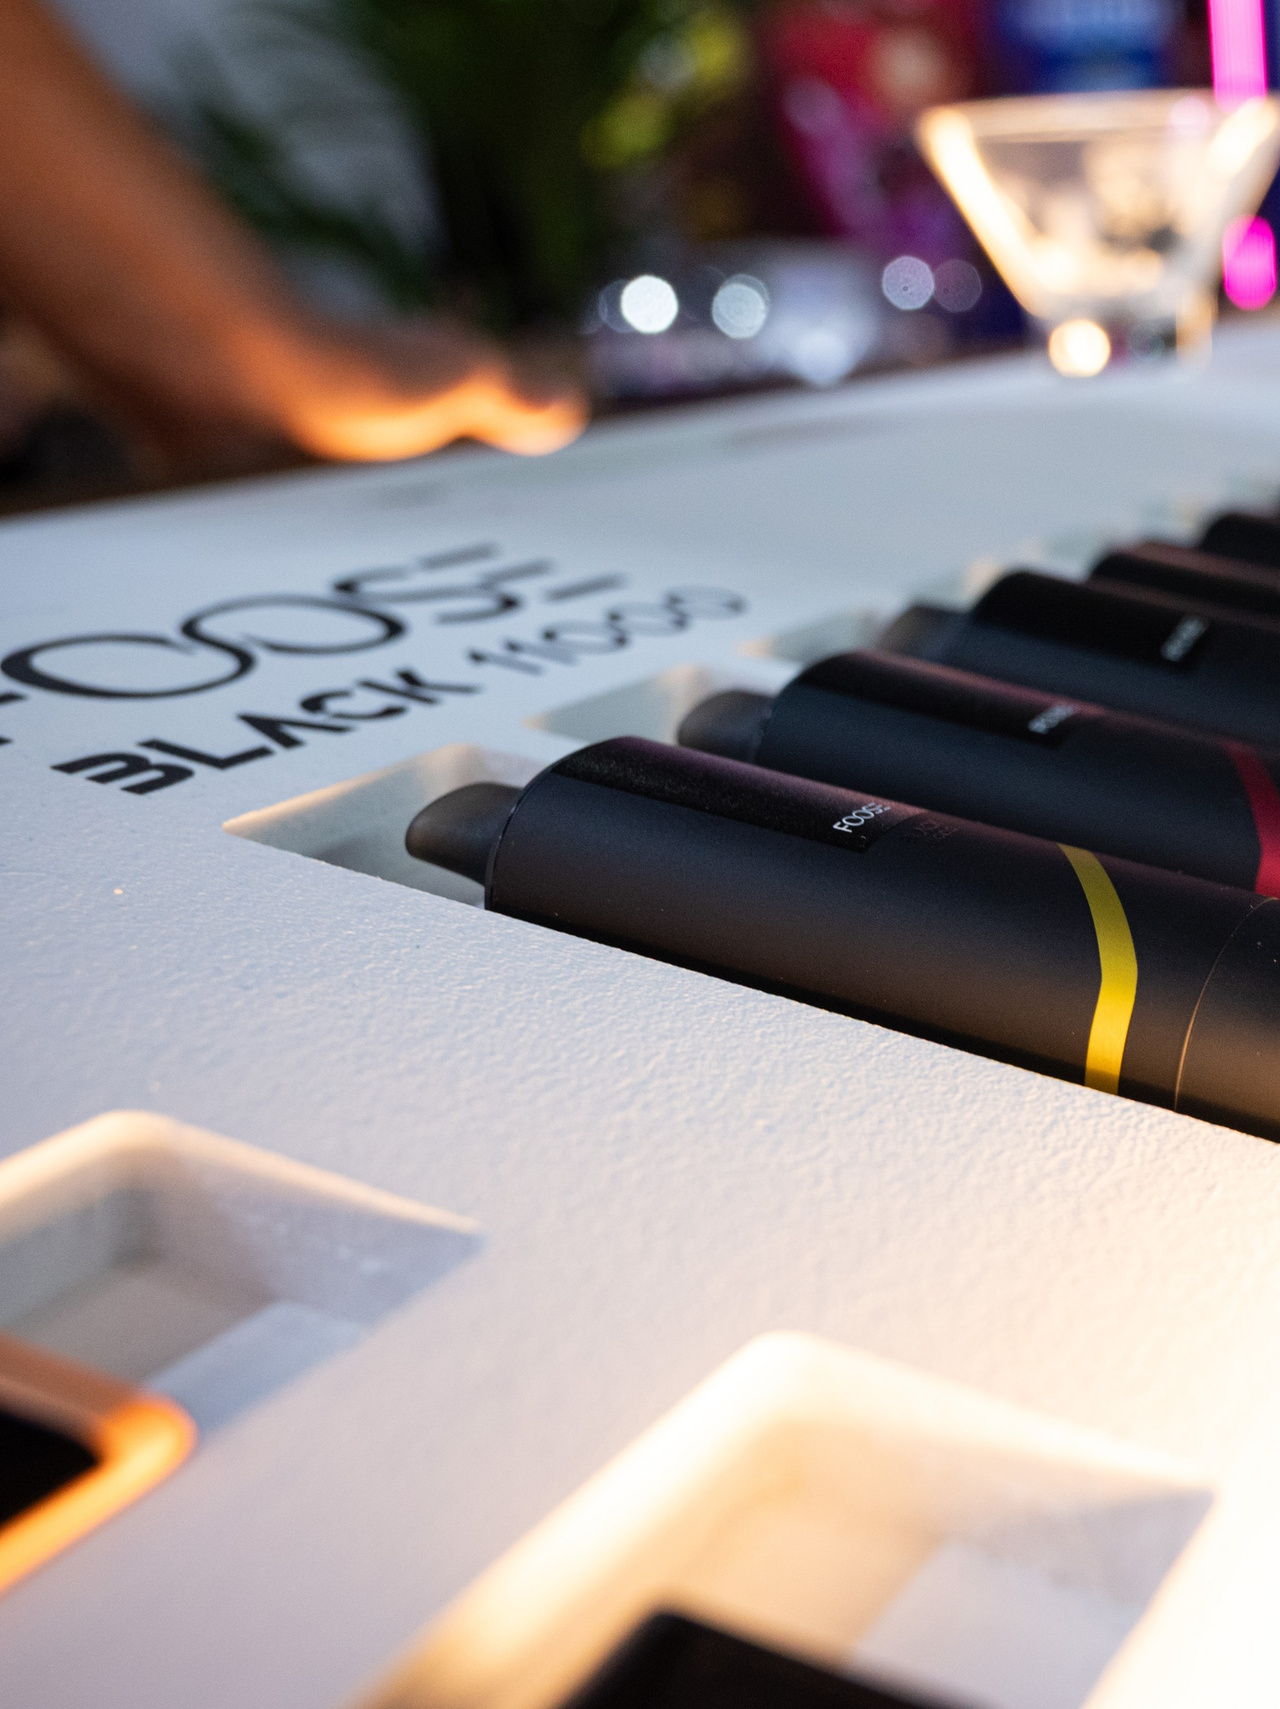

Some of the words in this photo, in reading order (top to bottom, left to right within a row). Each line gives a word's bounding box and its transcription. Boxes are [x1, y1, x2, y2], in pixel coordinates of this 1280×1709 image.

[50, 666, 482, 795] BLACK
[467, 584, 748, 675] 11000
[831, 801, 892, 833] FOOSE
